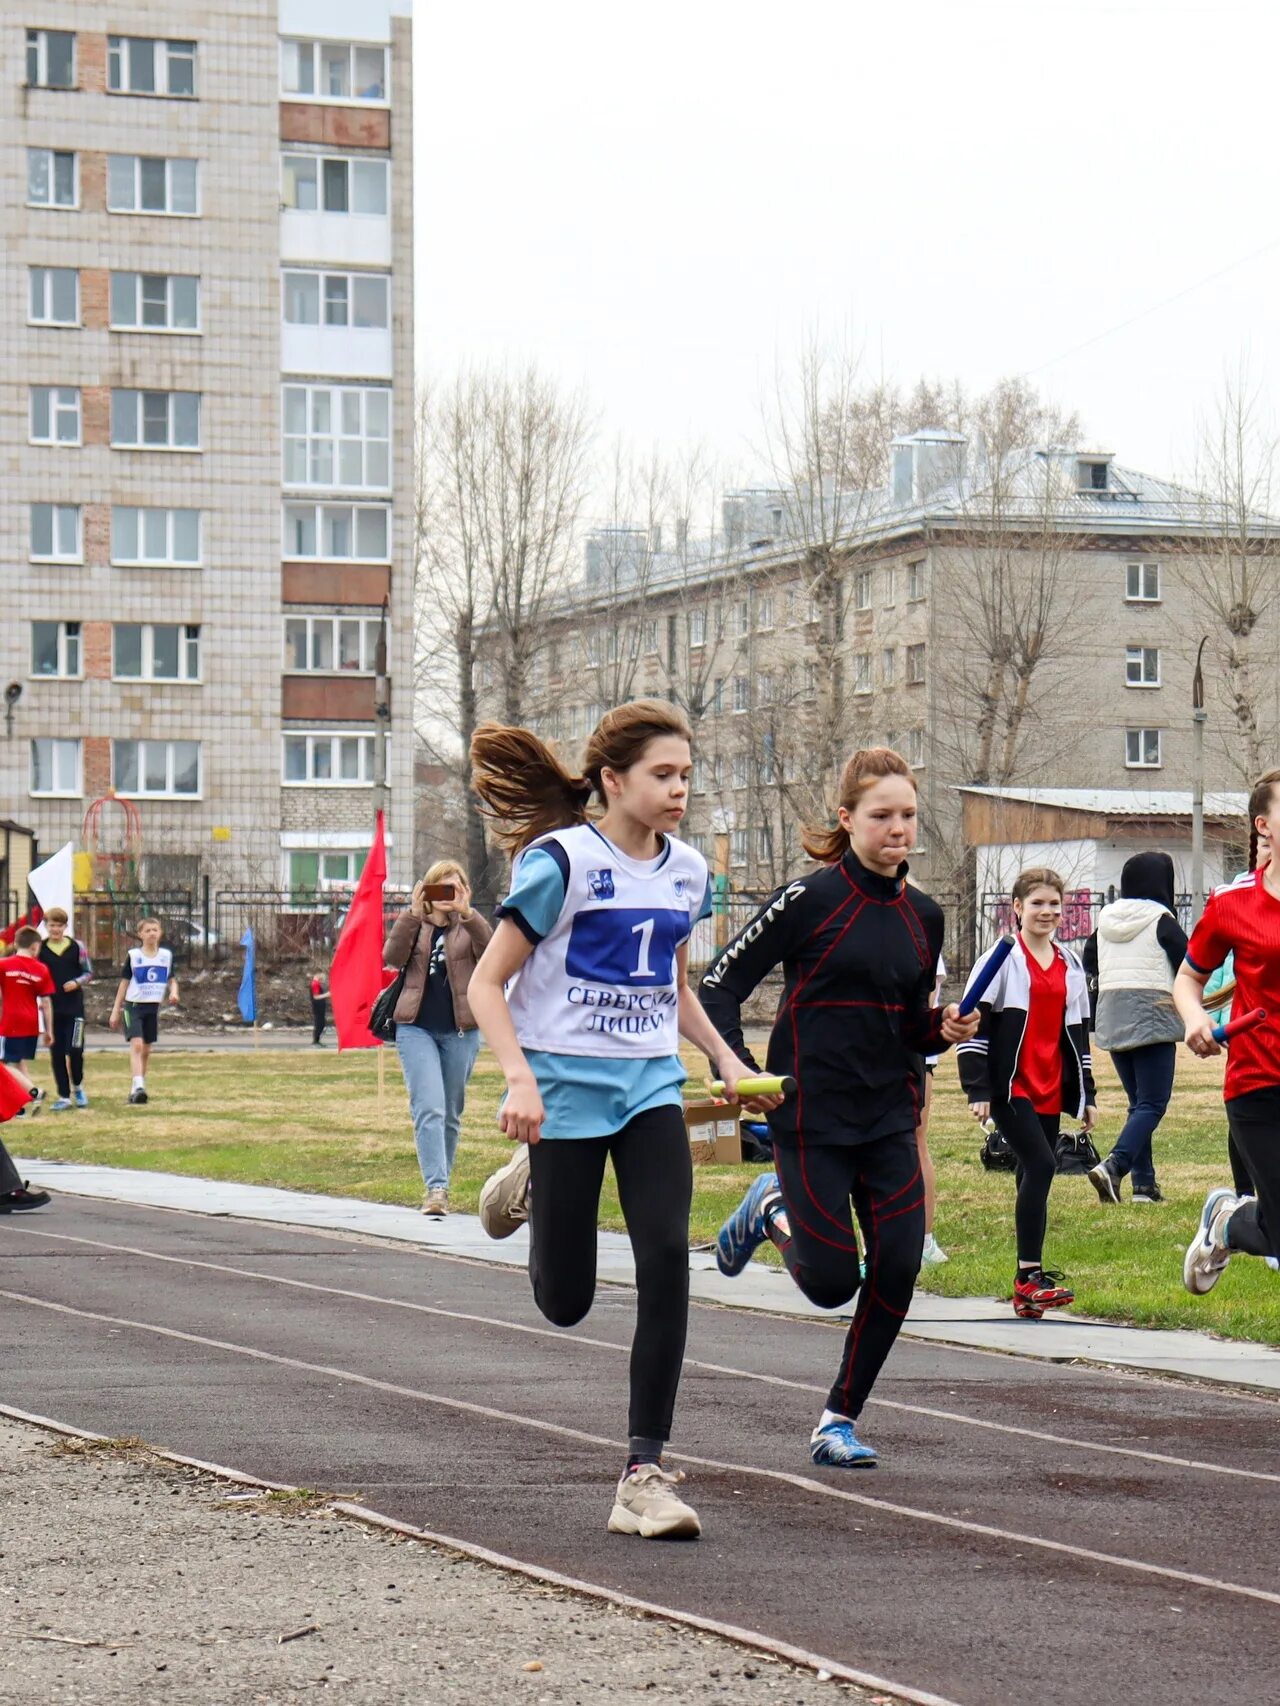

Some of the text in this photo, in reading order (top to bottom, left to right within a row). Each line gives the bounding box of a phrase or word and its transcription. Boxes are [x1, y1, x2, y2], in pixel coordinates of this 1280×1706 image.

[629, 918, 656, 977] 1
[702, 880, 807, 989] SALOMON
[146, 966, 158, 982] 6
[567, 986, 678, 1011] СЕВЕРСИ
